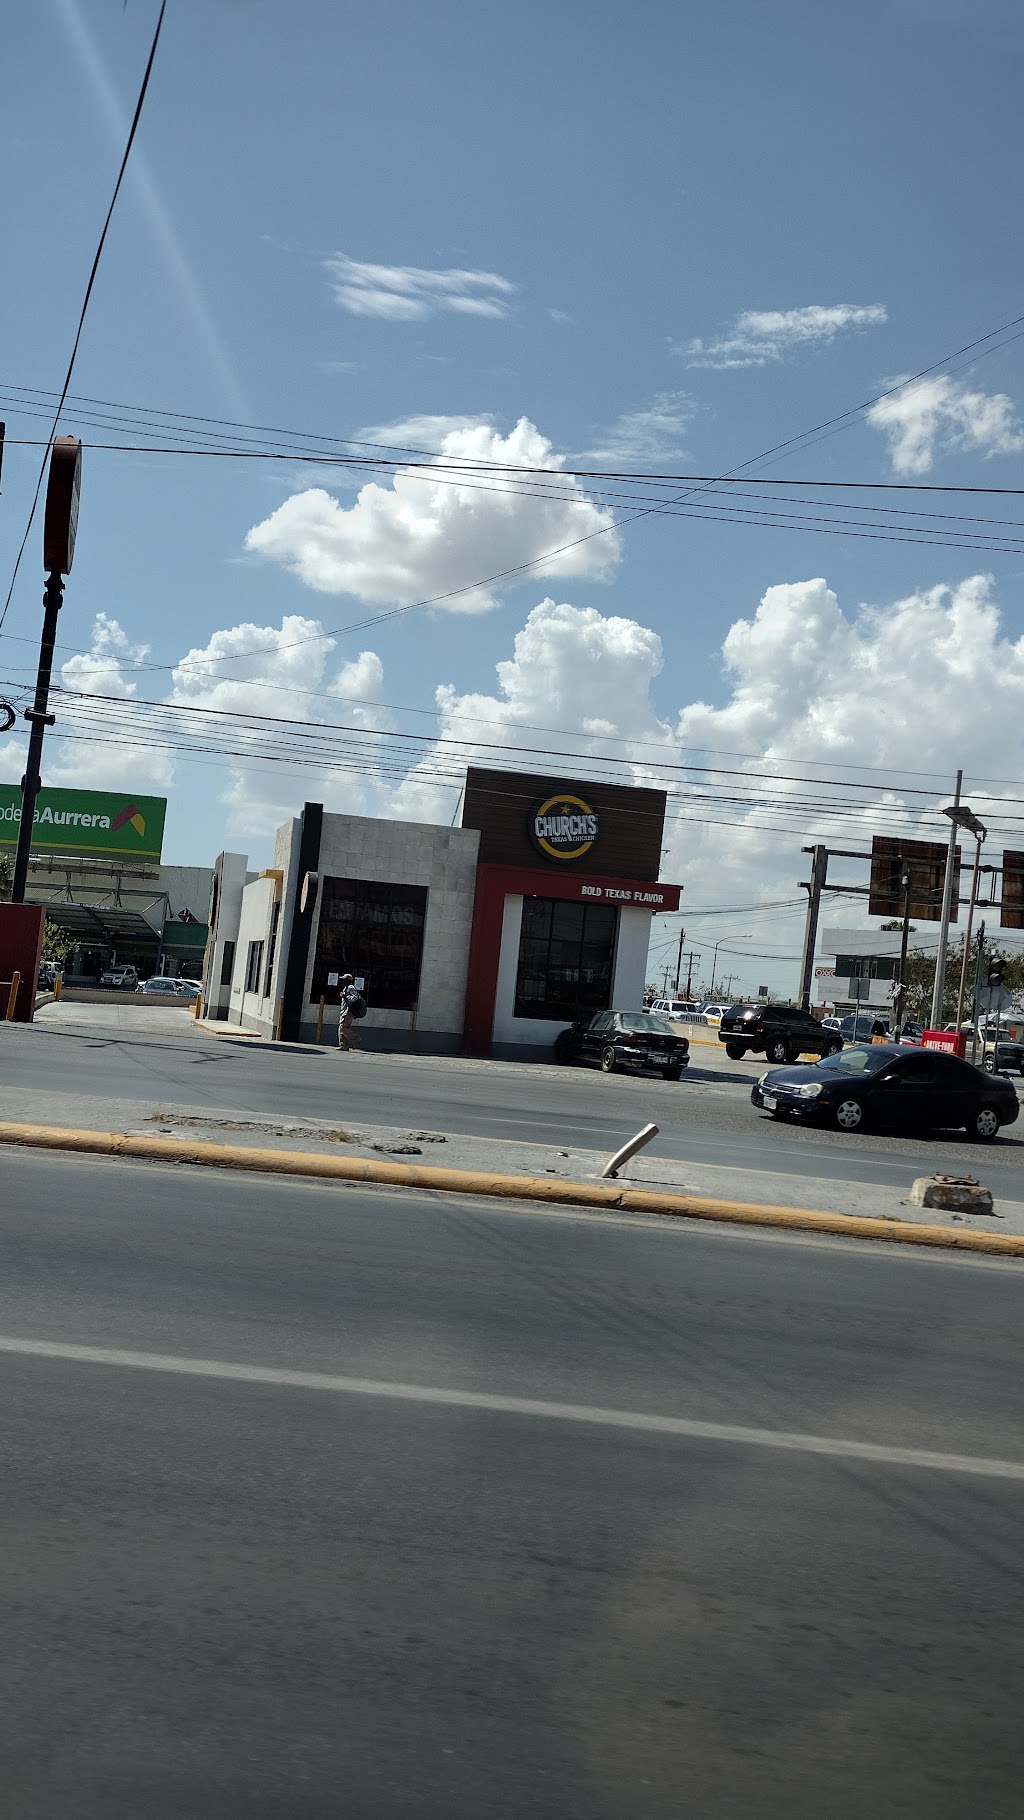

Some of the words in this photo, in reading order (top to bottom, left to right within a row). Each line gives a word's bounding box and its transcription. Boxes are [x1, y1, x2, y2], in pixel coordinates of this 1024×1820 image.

[40, 806, 110, 828] Aurrera
[581, 885, 601, 896] BOLD
[604, 888, 632, 899] TEXAS
[633, 891, 664, 903] FLAVOR
